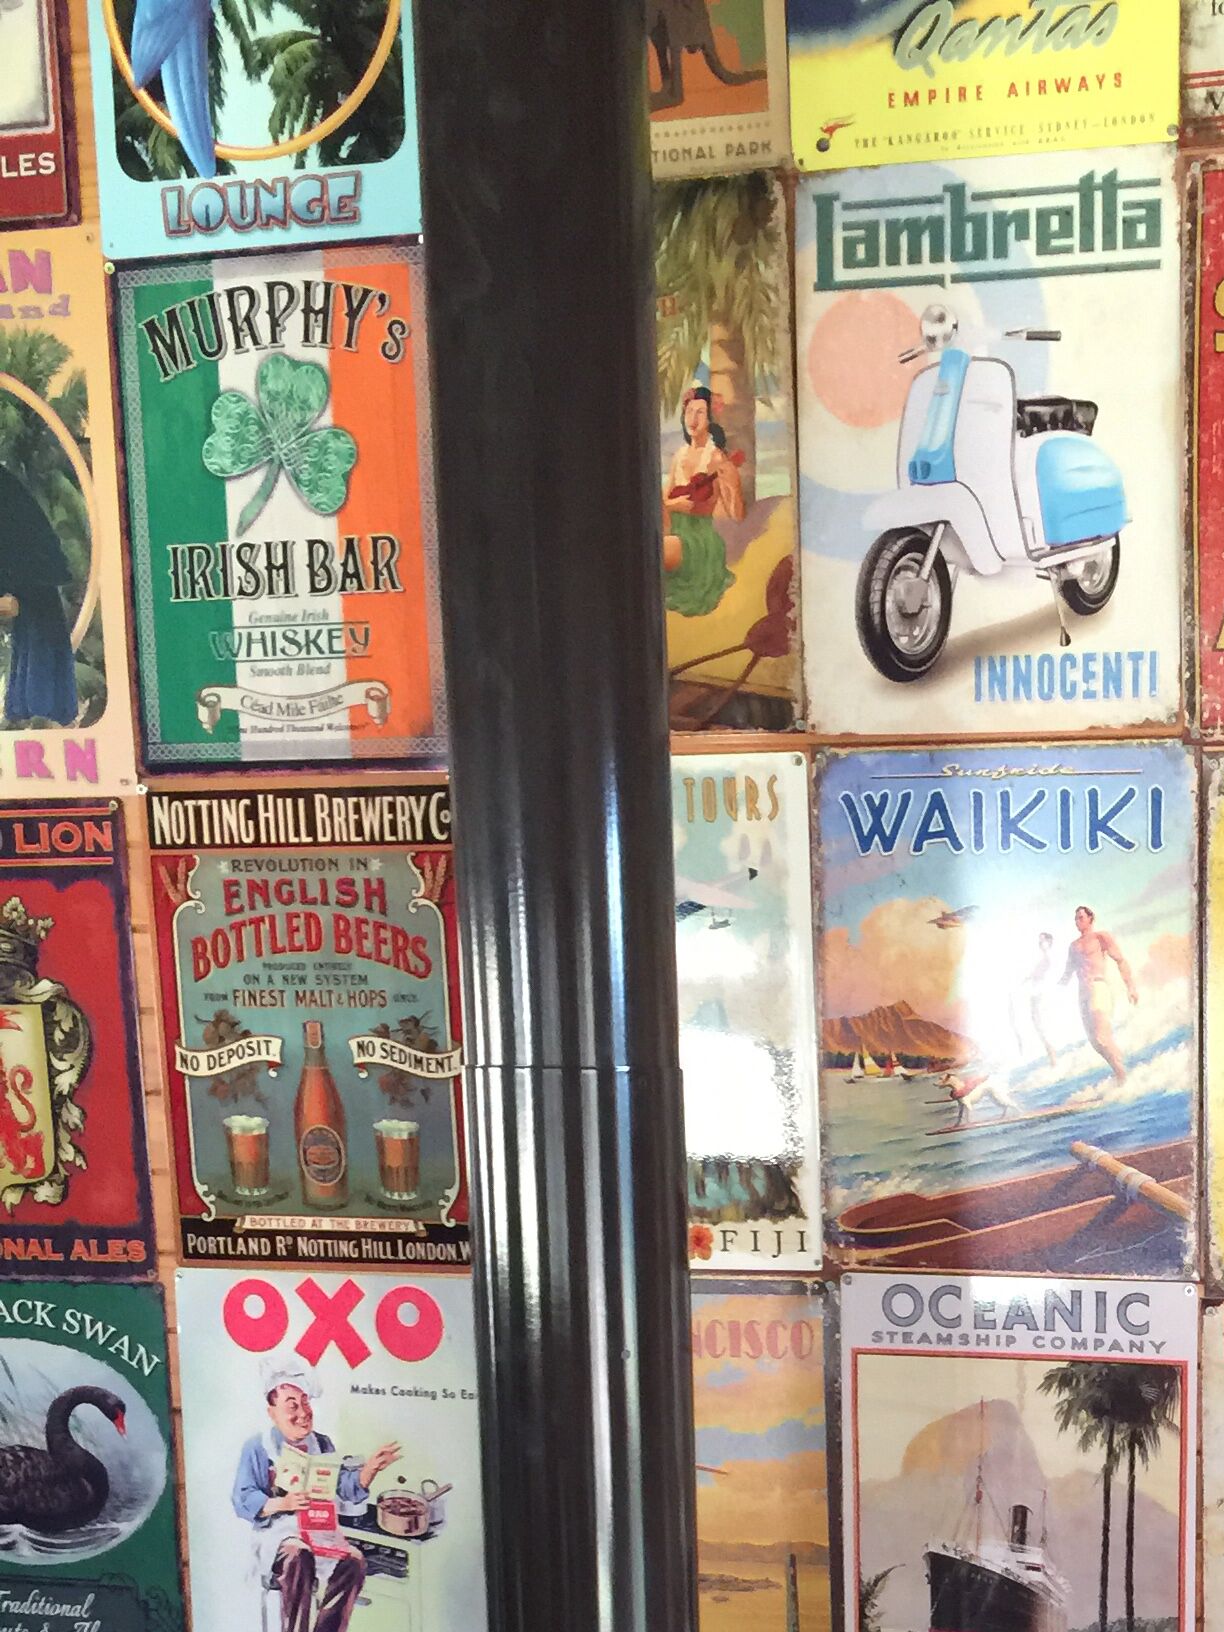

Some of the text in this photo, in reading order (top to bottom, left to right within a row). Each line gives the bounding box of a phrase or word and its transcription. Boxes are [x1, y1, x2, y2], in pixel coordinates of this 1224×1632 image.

[893, 0, 1119, 78] Qantas
[887, 72, 1124, 109] EMPIRE AIRWAYS
[725, 140, 772, 157] PARK
[161, 170, 362, 238] LOUNGE
[812, 168, 1162, 290] Lambretta
[167, 533, 405, 602] IRISH BAR
[209, 624, 371, 662] WHISKEY
[973, 650, 1160, 703] INNOCENTI
[682, 774, 780, 823] TOURS
[13, 820, 113, 854] LION
[151, 791, 430, 846] NOTTING HILL BREWERY
[838, 785, 1167, 857] WAIKIKI
[230, 856, 368, 873] REVOLUTION IN
[222, 876, 389, 917] ENGLISH
[189, 911, 433, 983] BOTTLED BEERS
[243, 973, 368, 985] ON NEW SYSTEM
[232, 989, 287, 1009] FINEST
[295, 989, 334, 1009] MALT
[348, 989, 388, 1008] HOPS
[178, 1055, 201, 1072] NO
[355, 1040, 377, 1058] NO
[250, 1217, 307, 1229] BOTTLED
[355, 1219, 411, 1231] BREWERY
[719, 1228, 808, 1255] FIJI
[70, 1238, 147, 1263] ALES
[187, 1233, 359, 1259] PORTLAND NOTTING
[222, 1277, 445, 1371] OXO
[881, 1283, 1152, 1337] OCEANIC
[62, 1307, 162, 1378] SWAN
[871, 1329, 1168, 1356] STEAMSHIP COMPANY
[350, 1383, 438, 1402] Makes Cooking
